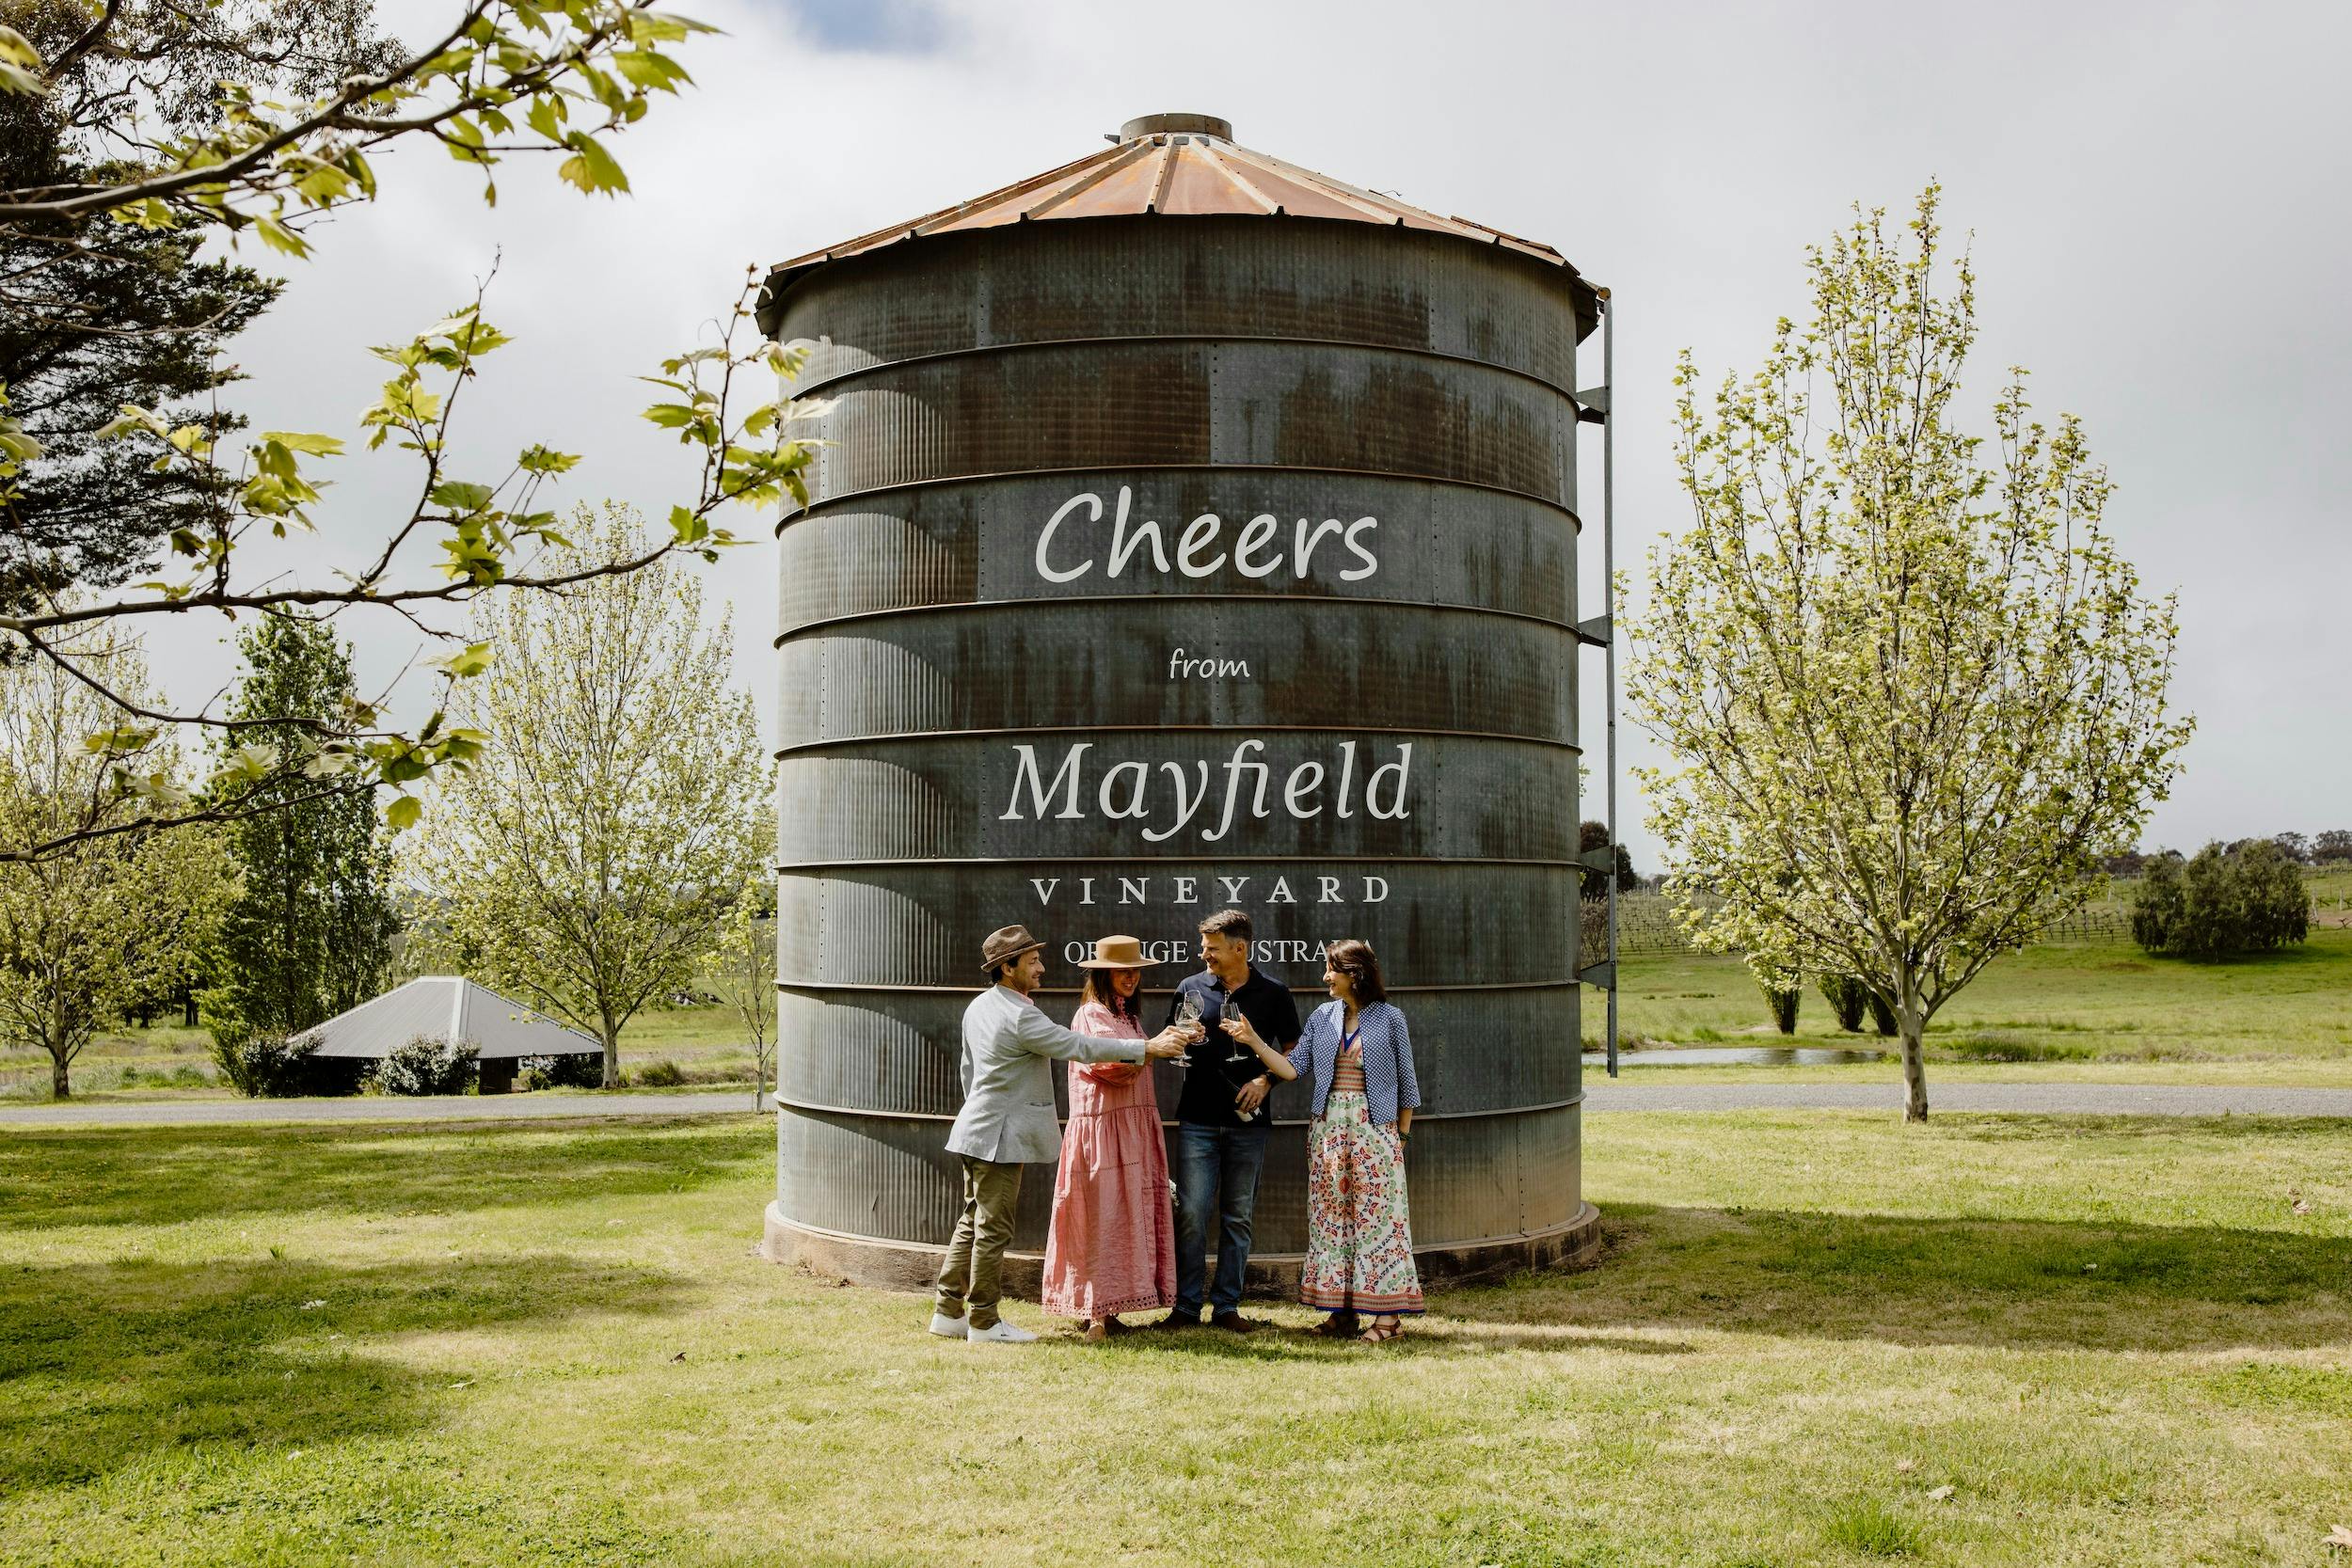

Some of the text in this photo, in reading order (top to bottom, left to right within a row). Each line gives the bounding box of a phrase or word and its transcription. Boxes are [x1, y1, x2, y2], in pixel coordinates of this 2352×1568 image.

[1035, 484, 1378, 583] Cheers
[1169, 647, 1250, 679] from
[998, 738, 1413, 842] Mayfield
[1029, 875, 1390, 906] VINEYARD
[1064, 941, 1189, 964] ORGE
